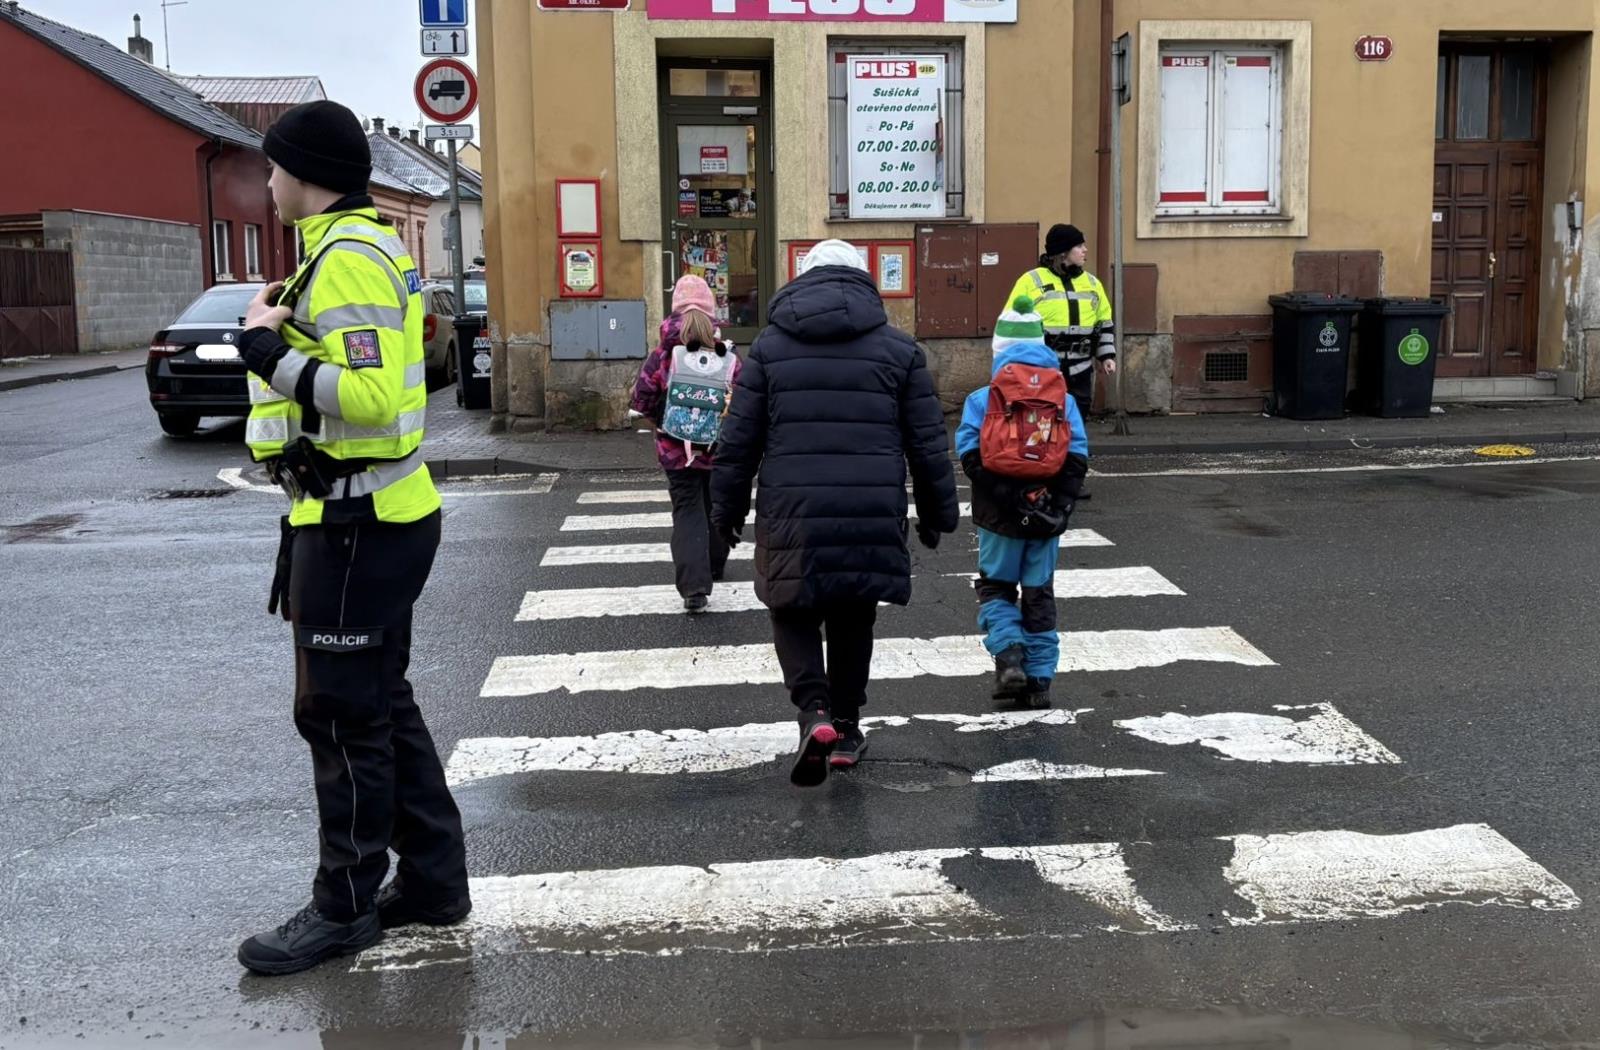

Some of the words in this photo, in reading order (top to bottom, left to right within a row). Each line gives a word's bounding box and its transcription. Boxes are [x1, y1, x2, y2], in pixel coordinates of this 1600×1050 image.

[1363, 41, 1385, 55] 116
[1171, 57, 1205, 66] PLUS
[856, 62, 910, 77] PLUS
[872, 87, 920, 97] Sušická
[856, 103, 903, 112] otevřeno
[312, 634, 369, 646] POLICIE
